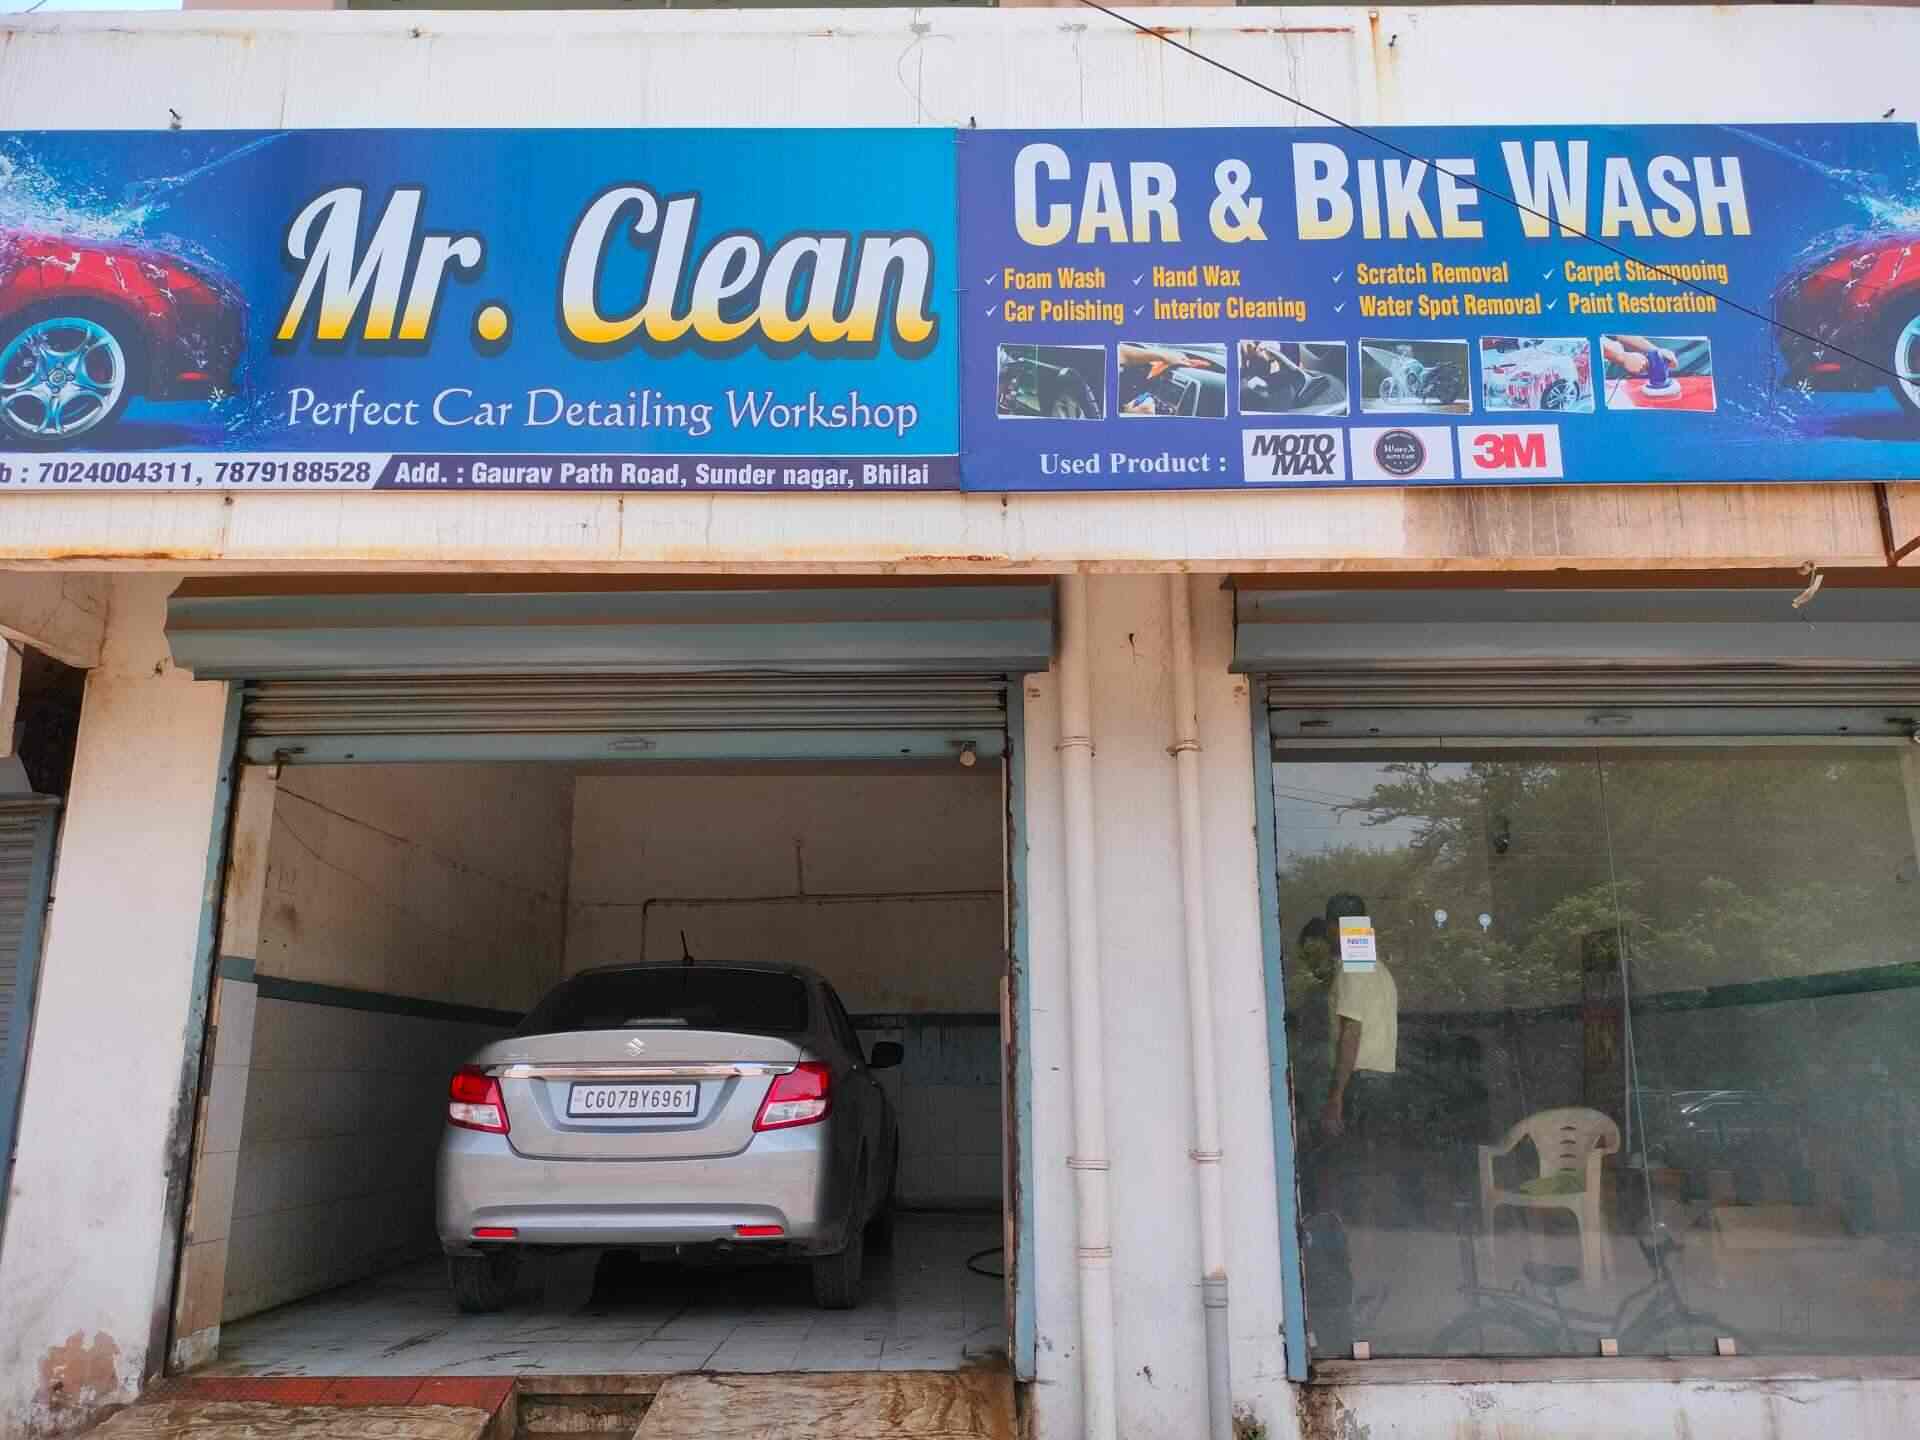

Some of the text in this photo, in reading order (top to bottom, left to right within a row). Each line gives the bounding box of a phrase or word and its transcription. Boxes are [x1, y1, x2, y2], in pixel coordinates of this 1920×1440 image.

[1208, 158, 1268, 243] &
[276, 187, 934, 343] Mr. Clean
[1003, 267, 1106, 289] Foam Wash
[1152, 265, 1241, 287] Hand Wax
[1356, 260, 1509, 285] Scratch Removal
[1564, 258, 1729, 287] Carpet Shampooing
[1003, 299, 1125, 325] Car Polishing
[1153, 296, 1307, 322] Interior Cleaning
[1359, 292, 1542, 320] Water Spot Removal
[1568, 289, 1717, 314] Paint Restoration
[287, 386, 919, 437] Perfect Car Detailing Workshop
[1251, 433, 1336, 457] MOTO
[1472, 432, 1547, 470] 3M
[38, 461, 204, 487] 7024004311,
[215, 461, 371, 485] 7879188528
[394, 461, 448, 484] Add.
[471, 462, 553, 485] Gaurav
[559, 462, 613, 485] Path
[620, 462, 687, 488] Road,
[695, 463, 776, 486] Sunder
[783, 466, 854, 490] nagar,
[863, 463, 929, 486] Bhilai
[1039, 452, 1101, 475] Used
[1110, 450, 1211, 474] Product
[1271, 453, 1337, 477] MAX
[584, 1089, 692, 1109] CG07BY6961
